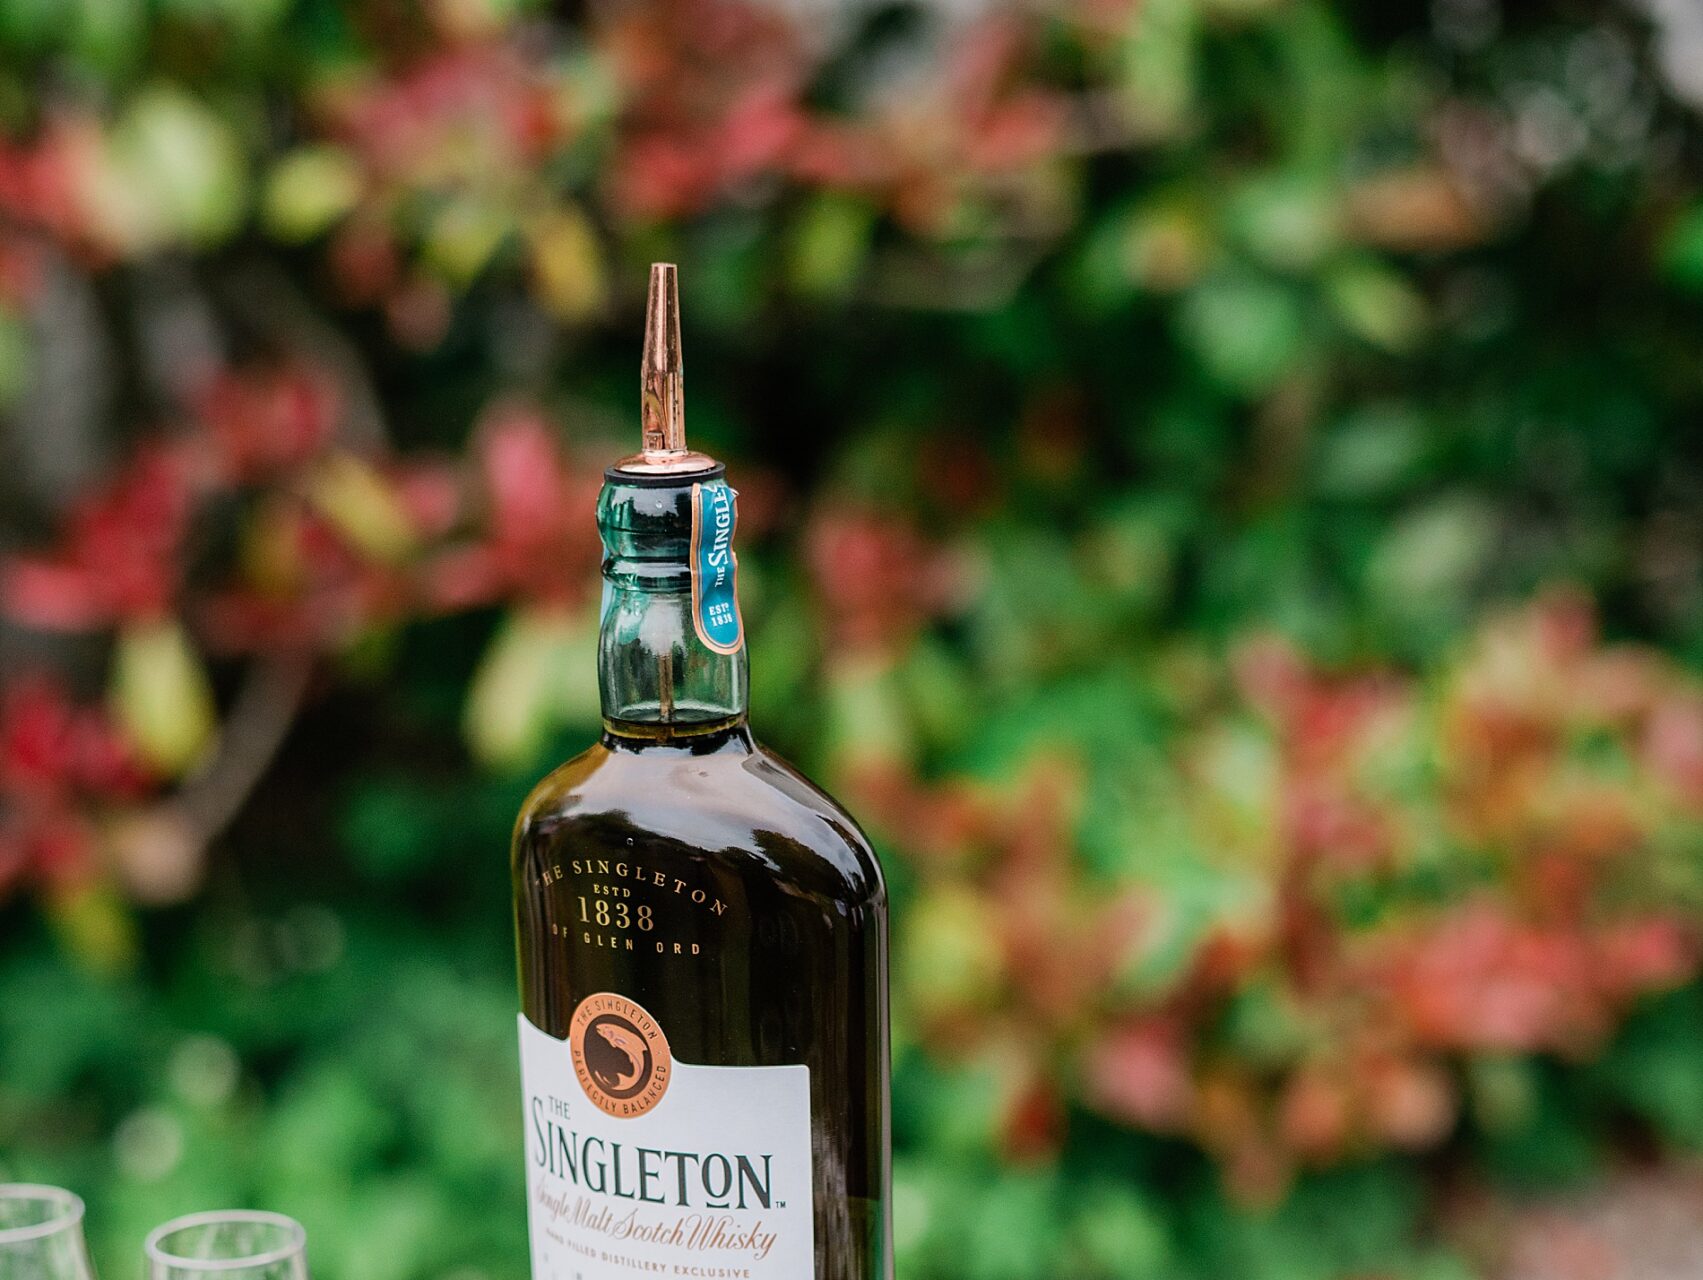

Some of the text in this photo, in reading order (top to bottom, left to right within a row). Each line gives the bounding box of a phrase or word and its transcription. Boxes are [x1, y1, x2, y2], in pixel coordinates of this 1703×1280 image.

[715, 566, 726, 588] THE
[535, 859, 728, 917] HE SINGLETON
[593, 883, 631, 898] ESTD
[578, 896, 654, 932] 1838
[584, 932, 634, 951] GLEN
[656, 942, 700, 955] ORD
[576, 999, 658, 1039] THE SINGLETON
[548, 1095, 571, 1120] THE
[623, 1065, 666, 1114] BALANCED
[532, 1096, 773, 1210] SINGLETON
[612, 1208, 684, 1247] Scotch
[685, 1214, 777, 1260] Whisky
[601, 1251, 667, 1273] DISTILLERY
[674, 1264, 750, 1279] EXCLUSIVE
